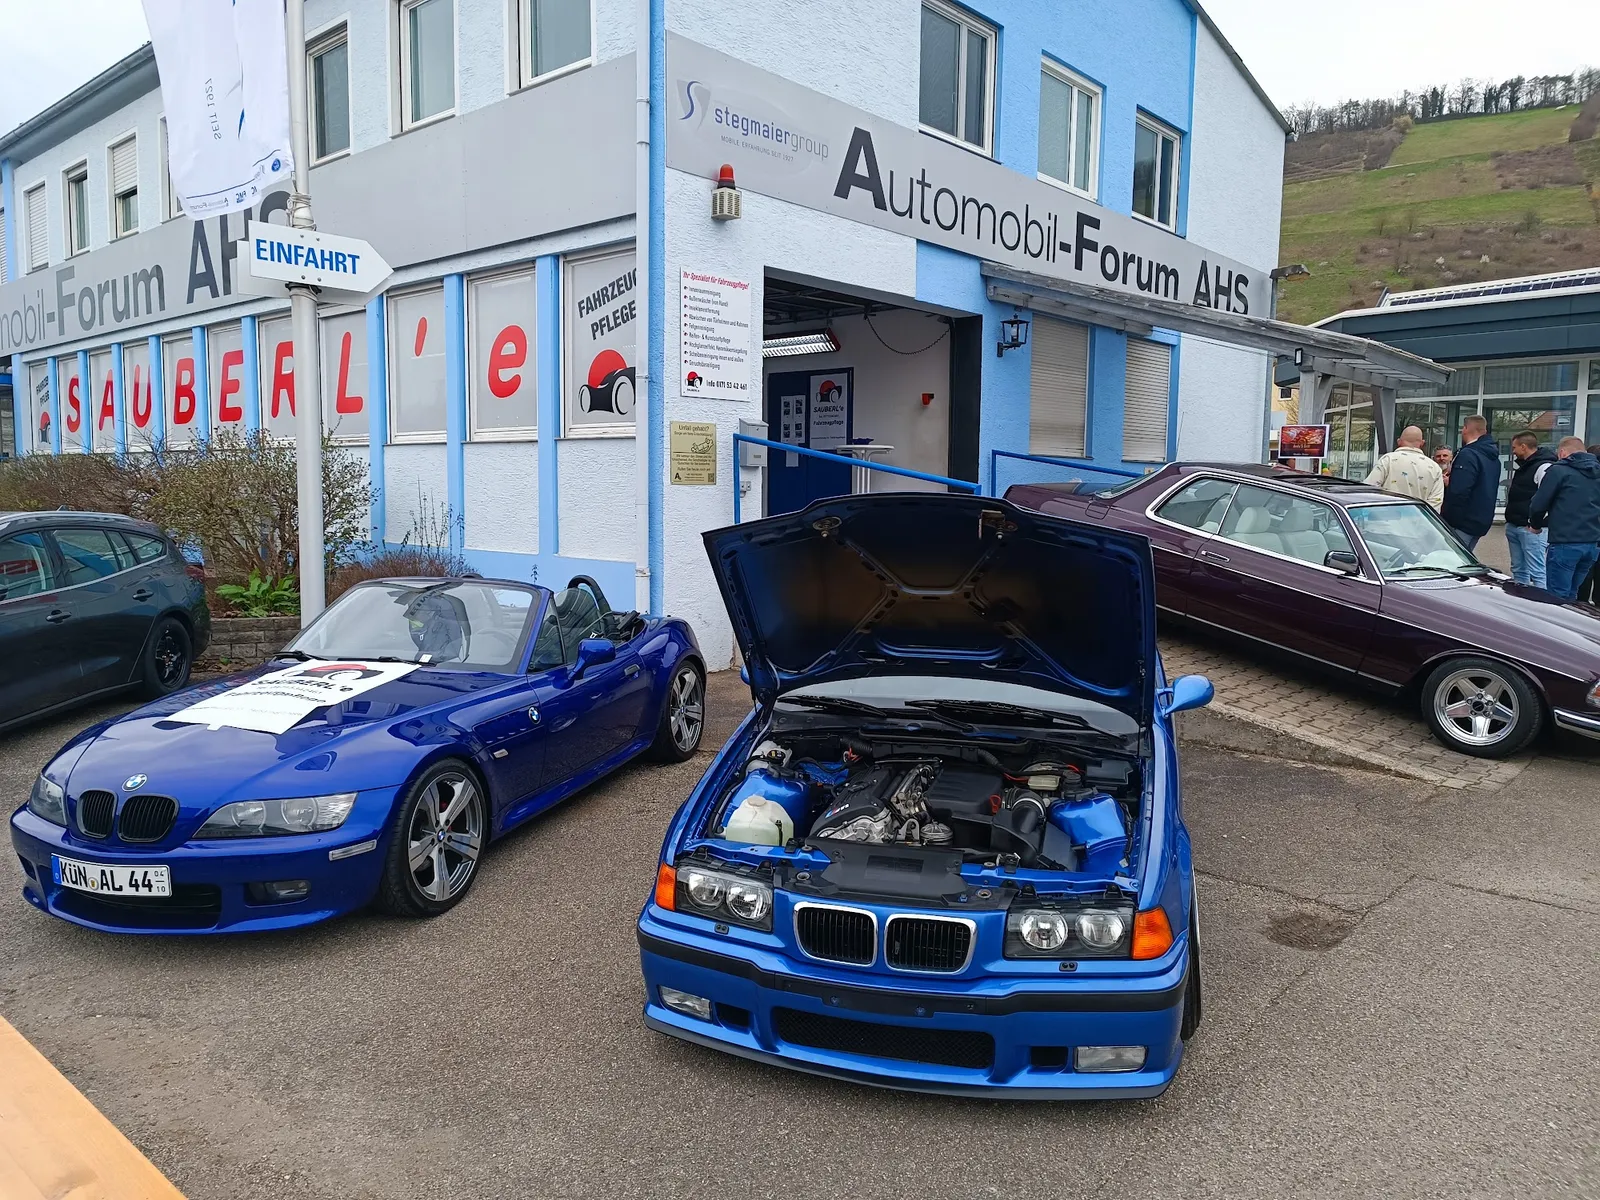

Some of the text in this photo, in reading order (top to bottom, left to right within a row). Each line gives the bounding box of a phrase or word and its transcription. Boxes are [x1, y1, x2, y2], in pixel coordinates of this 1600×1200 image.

[714, 106, 829, 161] stegmaiergroup
[720, 135, 794, 162] MOBILE ERFAHRUNG SEIT 1927
[833, 126, 1249, 314] Automobil-Forum AHS
[255, 238, 361, 275] EINFAHRT
[690, 272, 711, 283] Spezialist
[590, 299, 637, 341] PFLEGE
[60, 861, 153, 892] KÜN AL 44
[156, 885, 166, 893] 10
